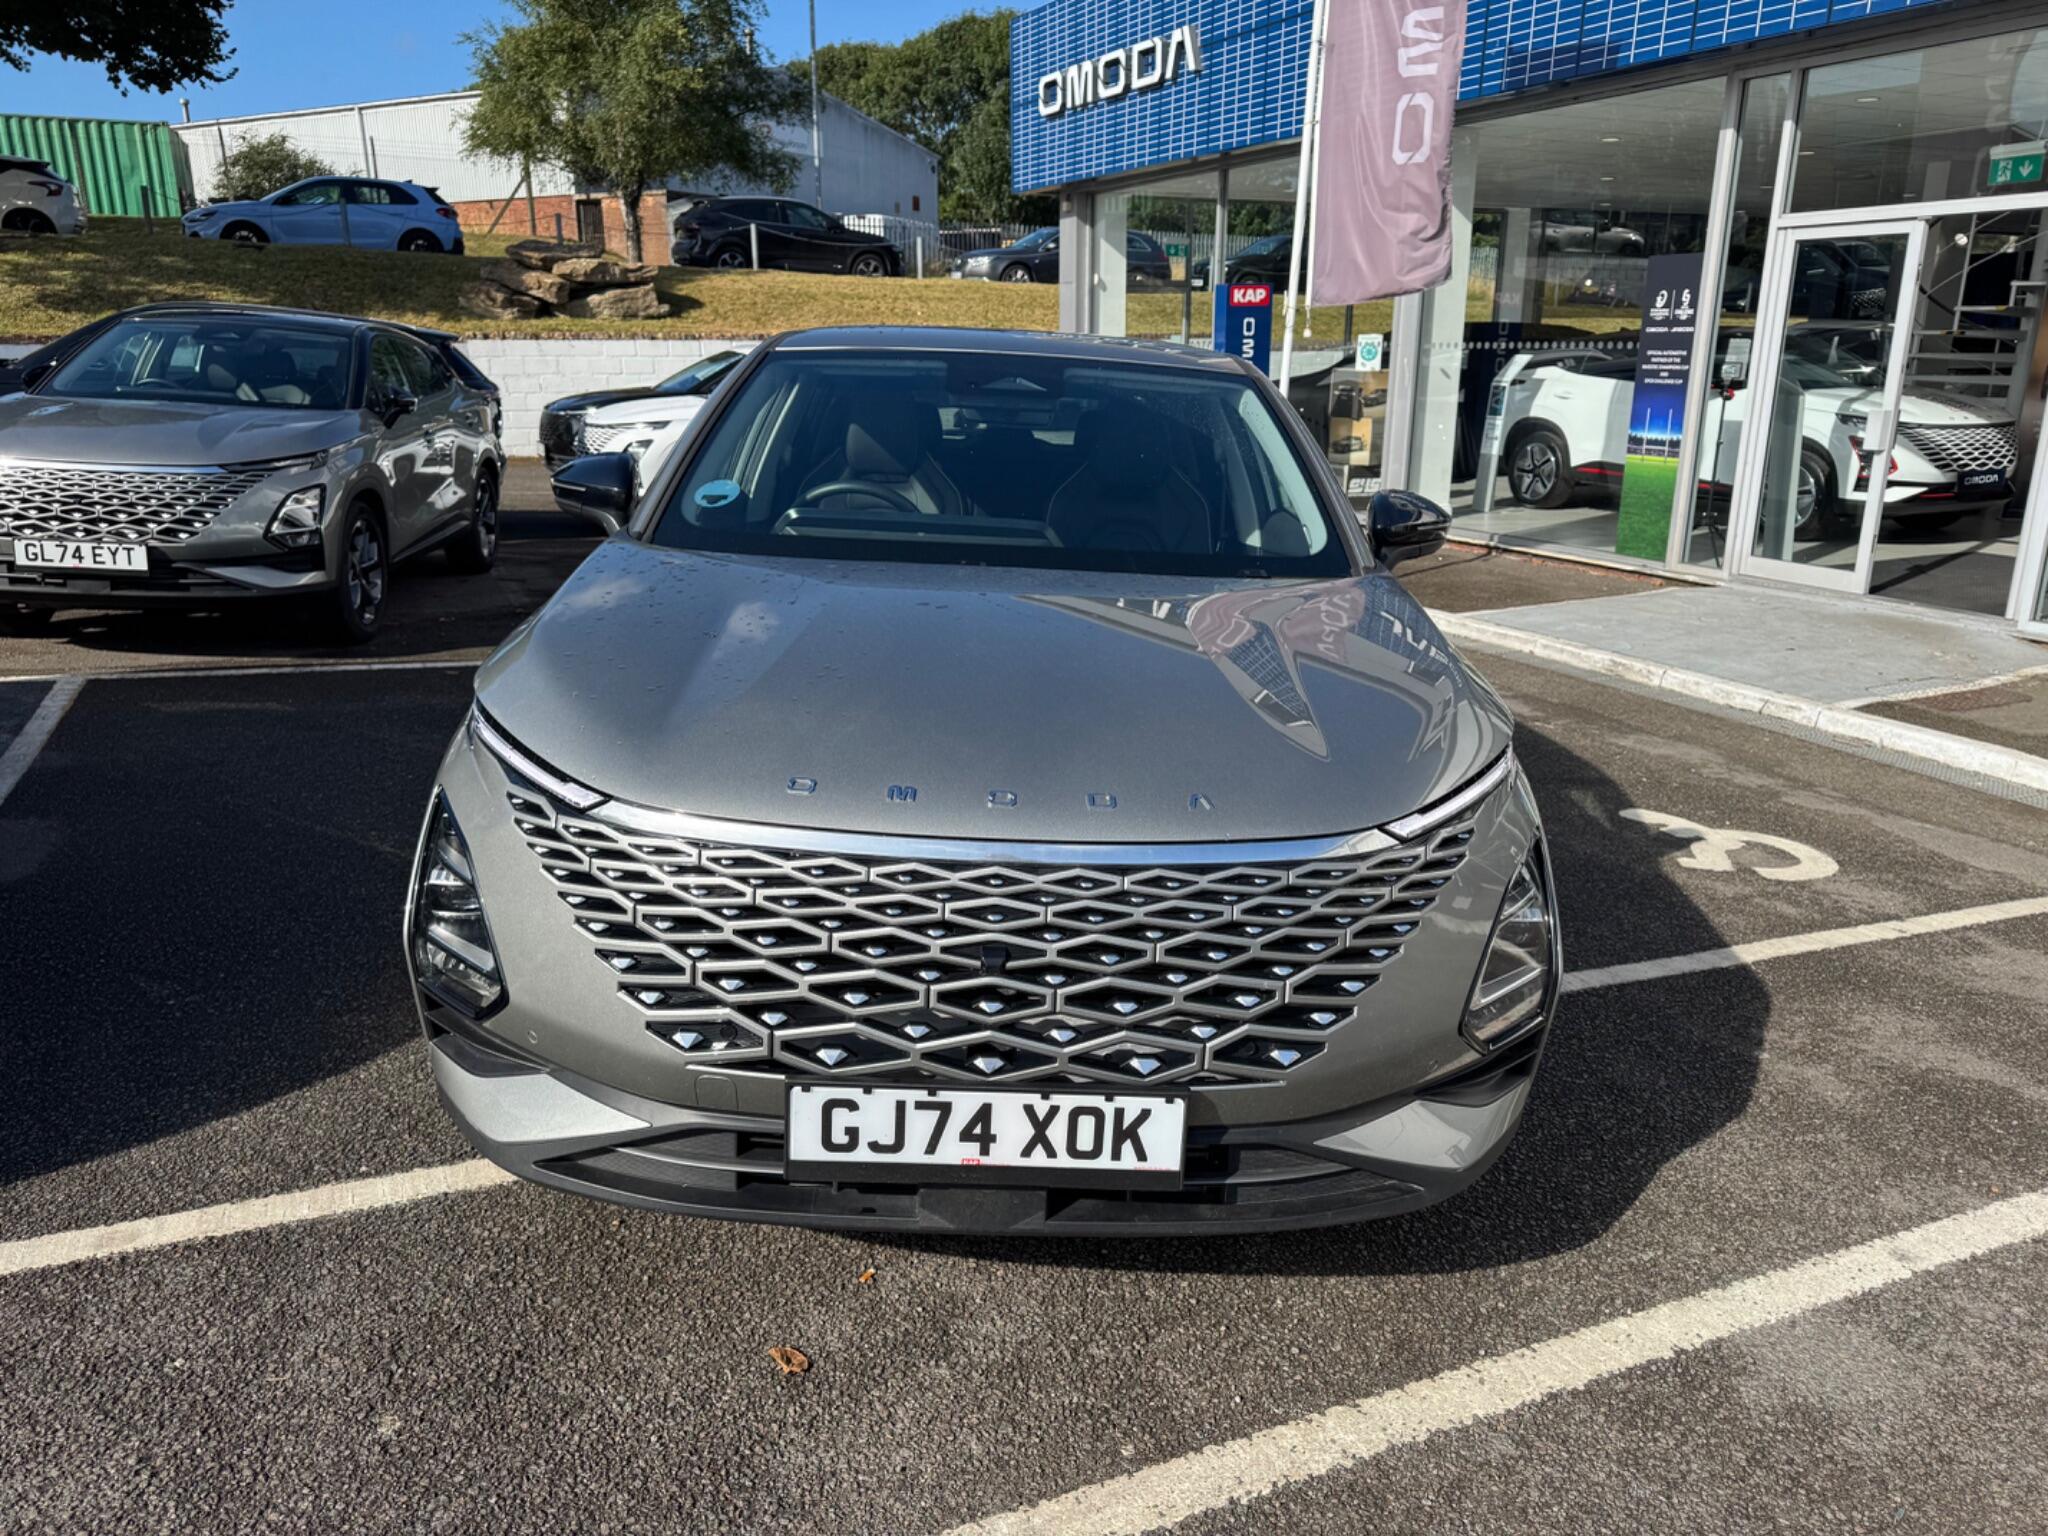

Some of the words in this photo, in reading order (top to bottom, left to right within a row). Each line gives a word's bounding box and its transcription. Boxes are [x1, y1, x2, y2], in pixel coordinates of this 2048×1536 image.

[1038, 25, 1200, 117] OMODA
[1233, 288, 1266, 303] KAP
[24, 543, 85, 564] GL74
[92, 546, 135, 566] EYT
[786, 776, 1215, 811] OMODA
[821, 1098, 997, 1156] GJ74
[1019, 1103, 1152, 1162] XOK
